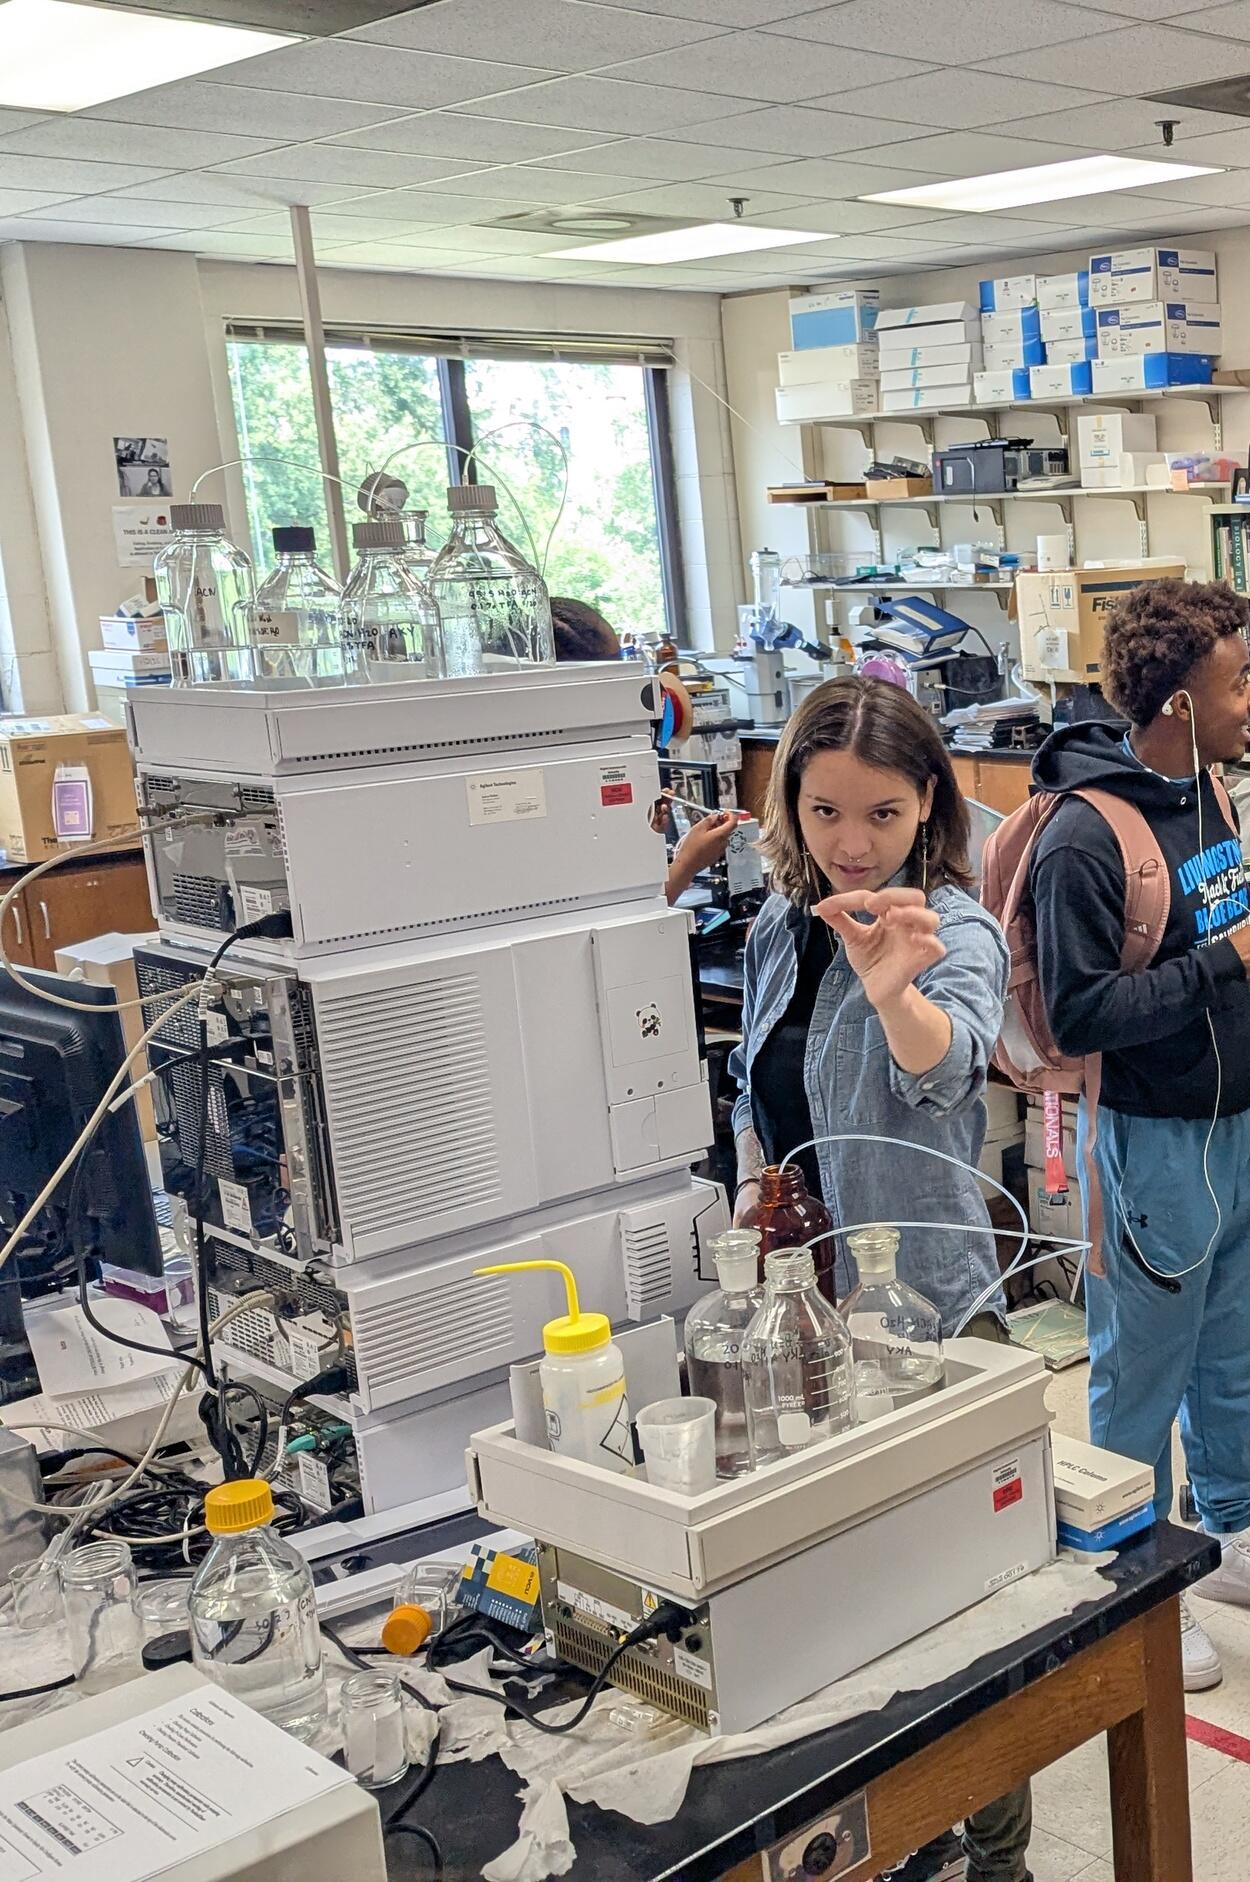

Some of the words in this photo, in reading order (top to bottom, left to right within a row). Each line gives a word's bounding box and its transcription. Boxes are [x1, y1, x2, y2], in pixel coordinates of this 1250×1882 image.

[1233, 525, 1243, 568] BIOLOGY
[196, 587, 216, 598] ACN
[778, 1395, 794, 1403] 1000
